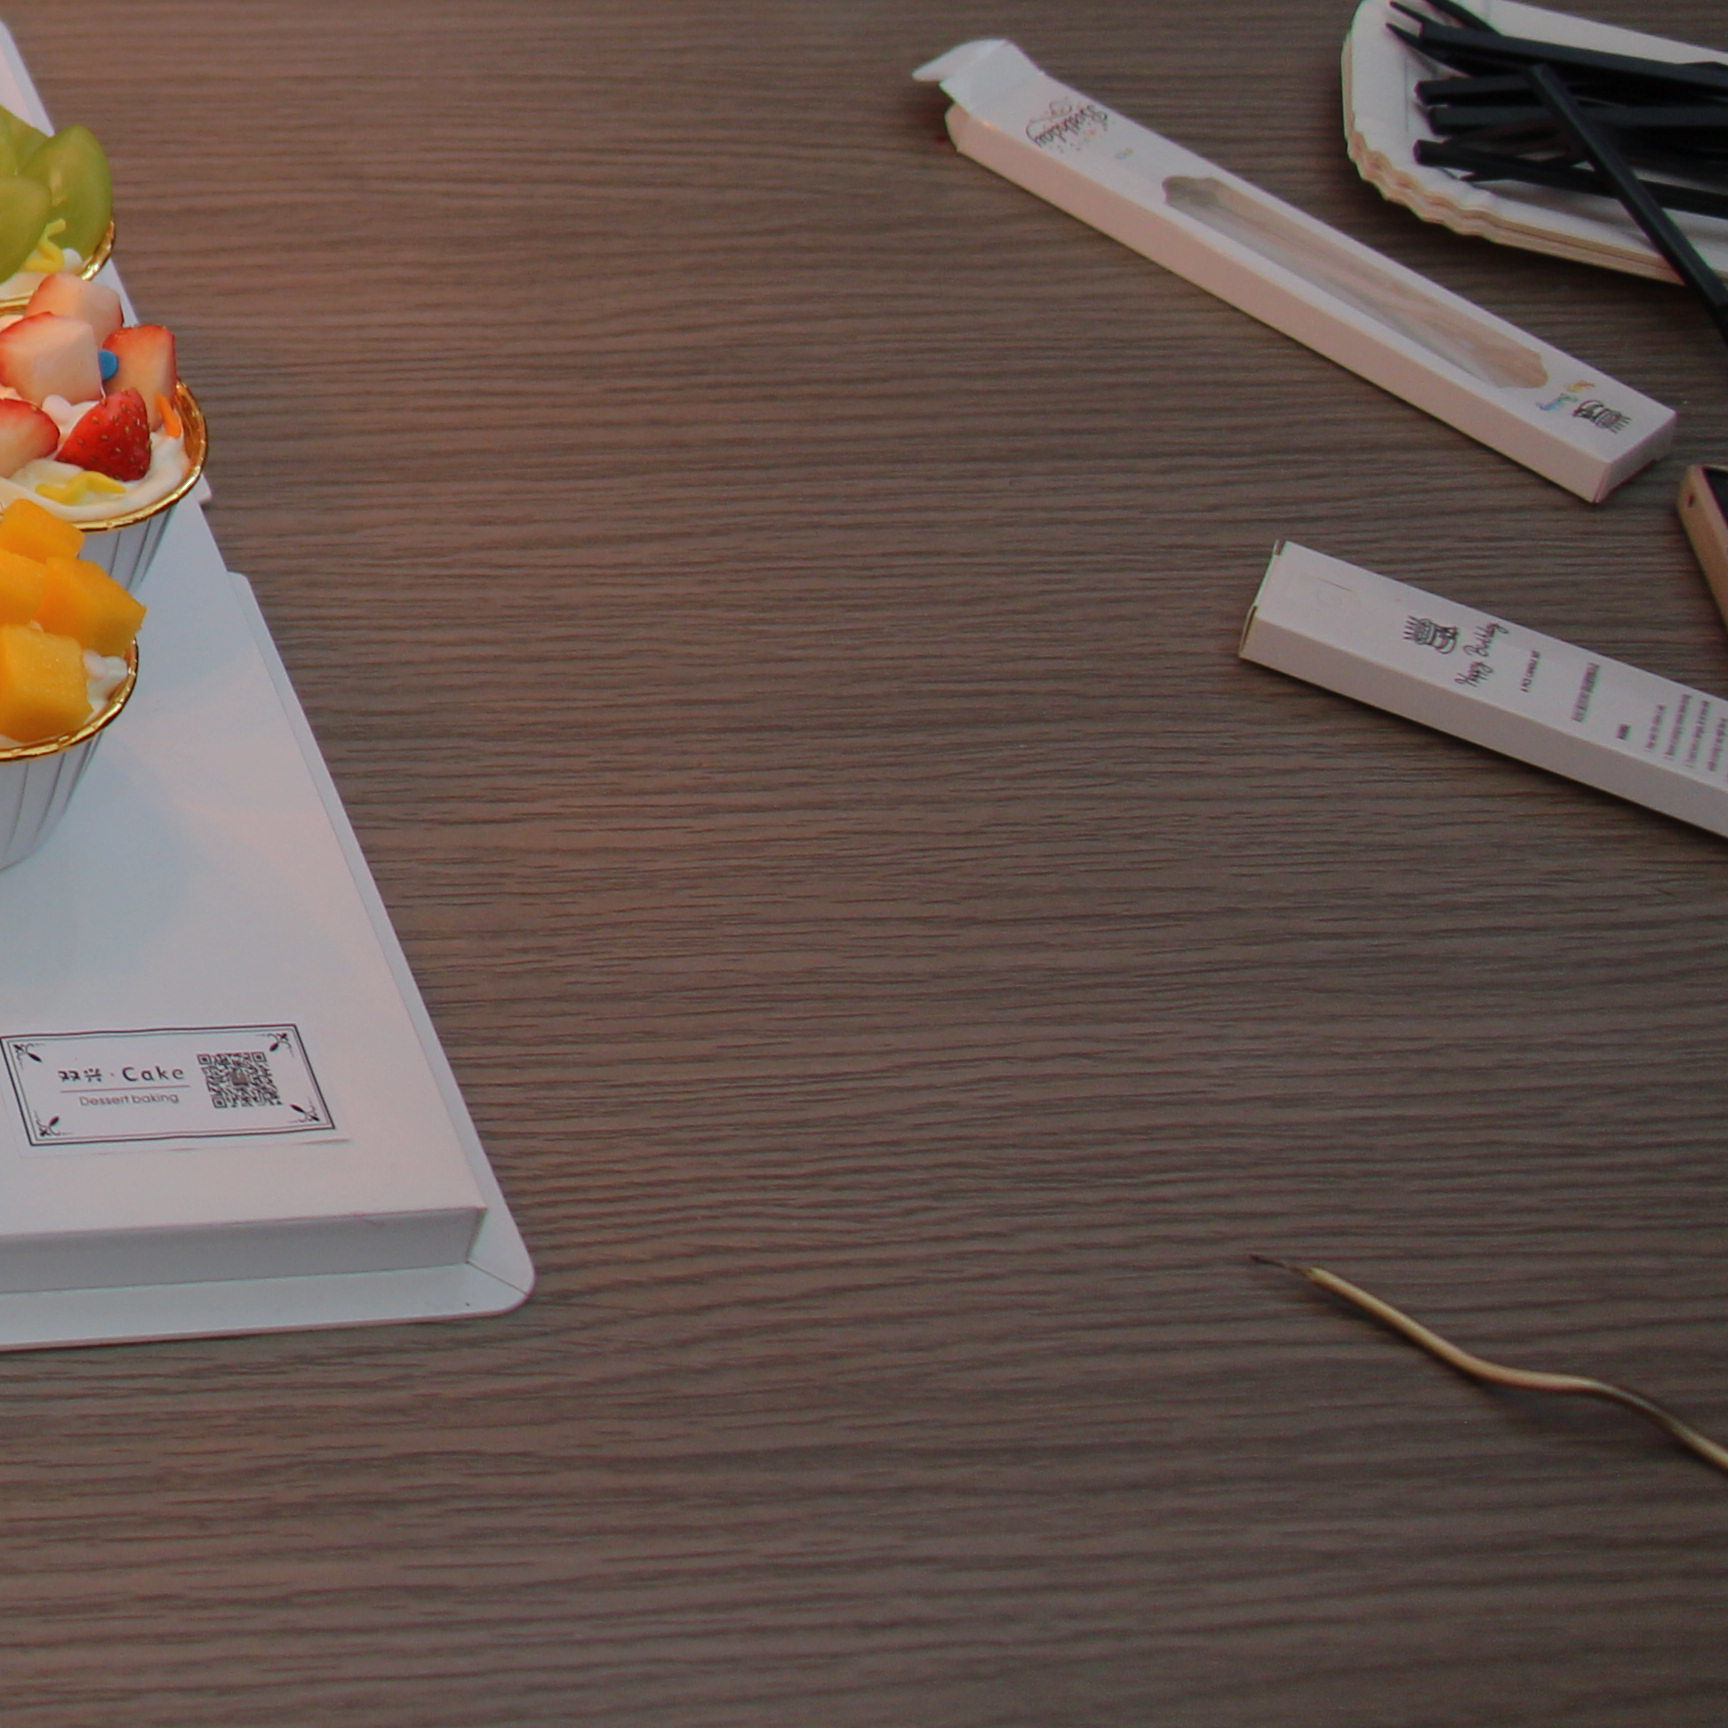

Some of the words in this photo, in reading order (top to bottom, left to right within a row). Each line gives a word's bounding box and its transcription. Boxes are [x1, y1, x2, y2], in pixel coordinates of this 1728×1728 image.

[121, 1065, 185, 1082] Cake
[79, 1094, 129, 1106] Dessert
[132, 1092, 179, 1105] baking
